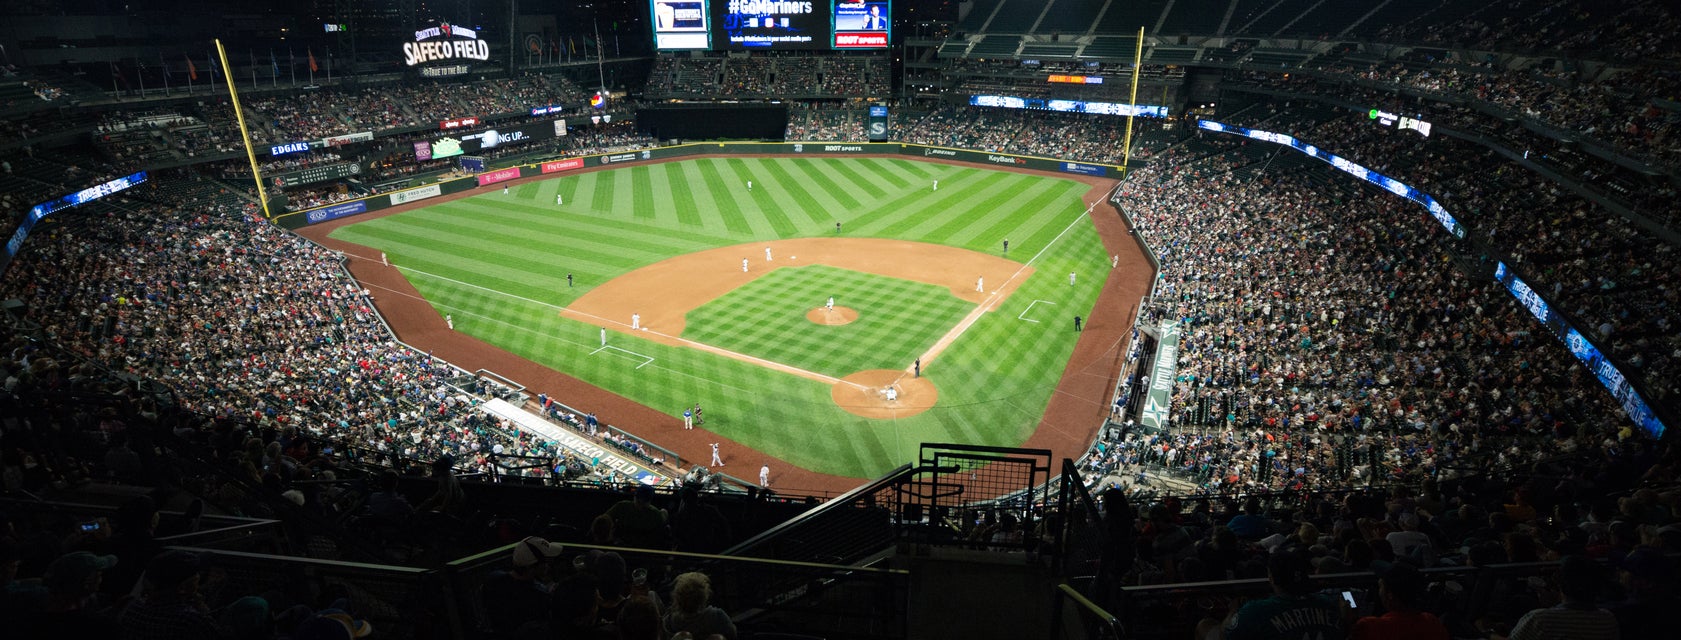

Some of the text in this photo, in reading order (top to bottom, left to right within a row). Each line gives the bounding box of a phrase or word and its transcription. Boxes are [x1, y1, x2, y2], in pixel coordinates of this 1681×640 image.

[728, 0, 813, 14] #GoMariners
[837, 35, 859, 44] ROOT
[403, 39, 490, 66] SAFECO FIELD
[429, 67, 441, 76] TRUE
[511, 131, 529, 141] UP...
[988, 154, 1015, 164] KeyBank
[557, 161, 579, 169] Emirates
[1599, 361, 1620, 380] TRUE
[562, 437, 604, 459] SAFECO
[600, 455, 638, 475] FIELD
